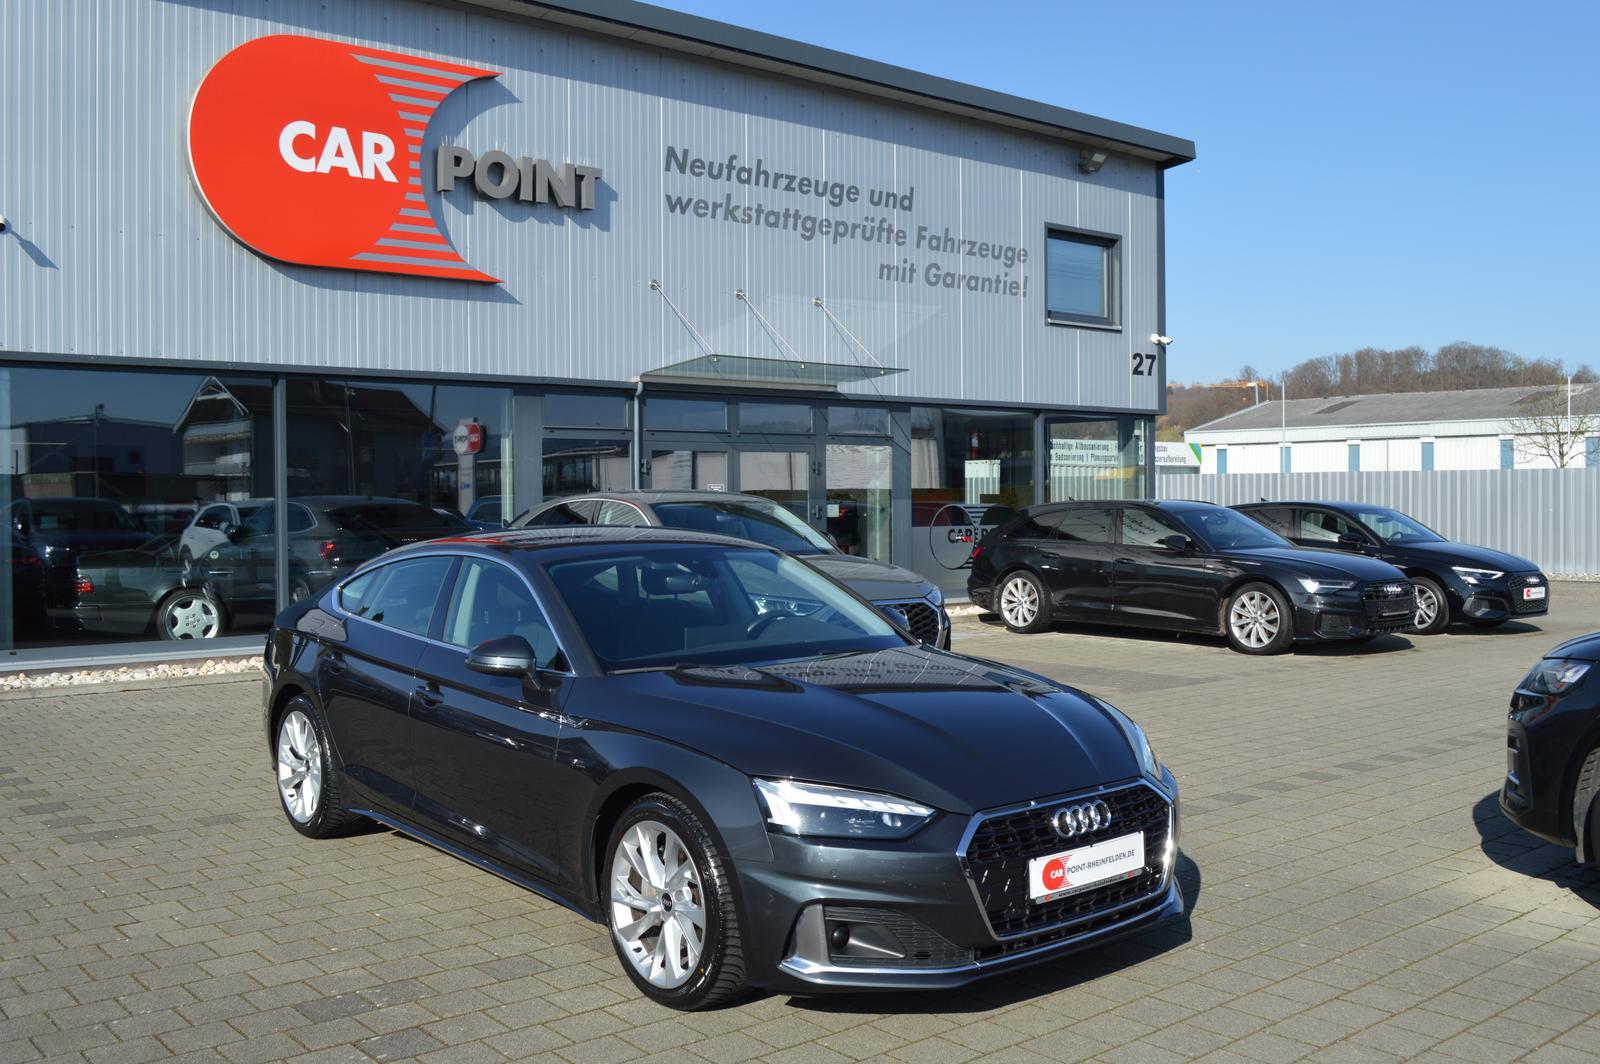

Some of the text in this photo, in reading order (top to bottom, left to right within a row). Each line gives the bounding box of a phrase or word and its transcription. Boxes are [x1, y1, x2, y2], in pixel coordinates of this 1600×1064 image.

[278, 120, 398, 183] CAR
[436, 144, 601, 211] POINT
[664, 145, 914, 212] Neufahrzeuge und
[664, 193, 1029, 268] werkstattgeprüfte Fahrzeuge
[878, 258, 1028, 298] mit Garantie!
[1132, 352, 1157, 377] 27
[1050, 849, 1135, 879] CAR POINT-RHEINFELDEN.DE
